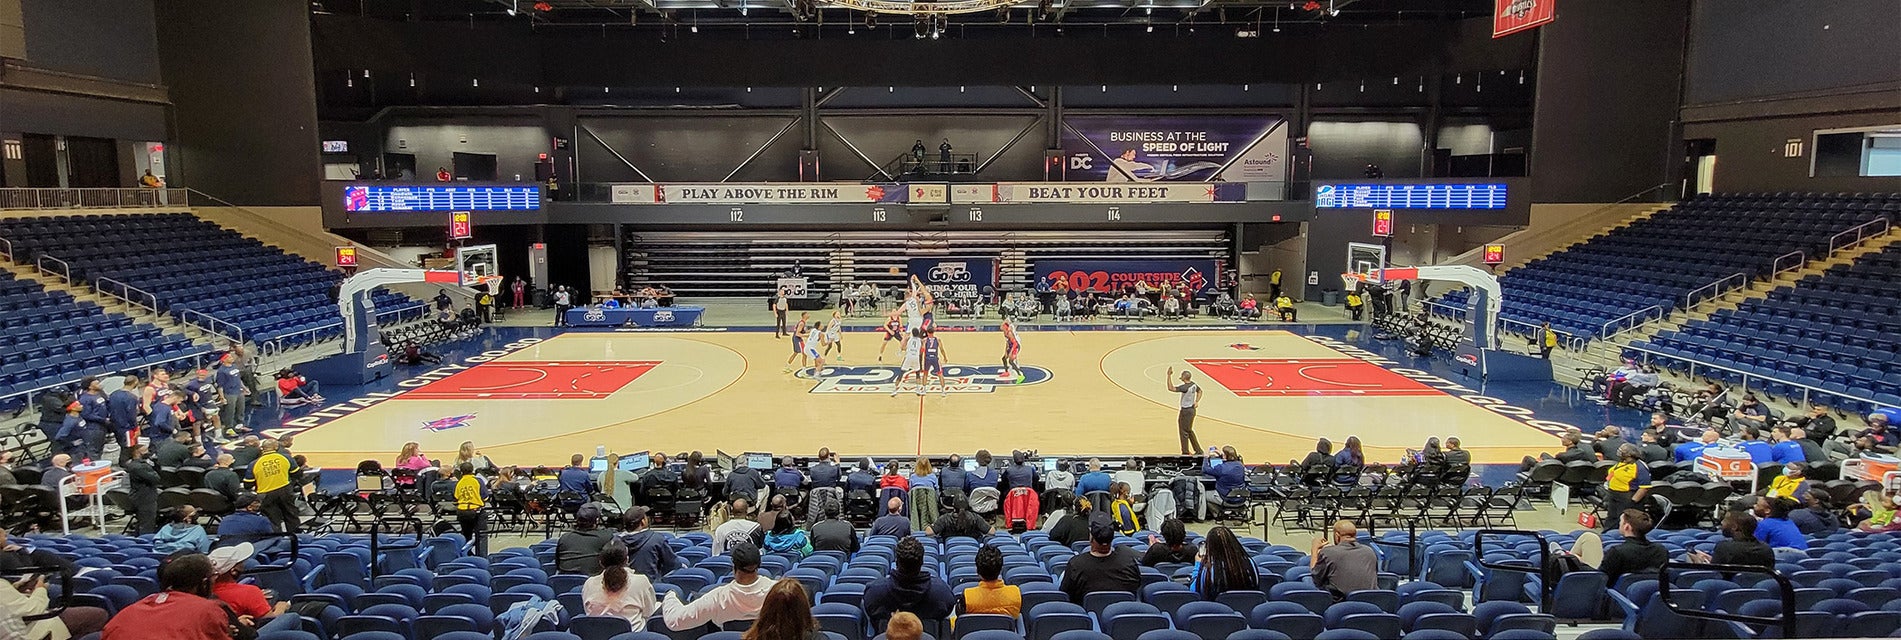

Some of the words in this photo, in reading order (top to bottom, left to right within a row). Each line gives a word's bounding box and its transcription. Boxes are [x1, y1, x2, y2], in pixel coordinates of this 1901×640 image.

[1110, 131, 1164, 142] BUSINESS
[1166, 131, 1181, 141] AT
[1183, 131, 1207, 141] THE
[5, 144, 22, 159] 111
[1142, 142, 1177, 152] SPEED
[1179, 142, 1195, 152] OF
[1197, 142, 1229, 152] LIGHT
[1785, 142, 1803, 157] 101
[682, 188, 719, 199] PLAY
[724, 188, 774, 199] ABOVE
[777, 188, 807, 199] THE
[810, 188, 838, 199] RIM
[1029, 187, 1073, 199] BEAT
[1077, 187, 1123, 199] YOUR
[1127, 187, 1169, 199] FEET
[730, 210, 743, 222] 112
[873, 210, 886, 222] 113
[969, 210, 982, 222] 113
[1107, 209, 1120, 221] 114
[455, 222, 466, 235] 24
[341, 255, 352, 263] 24
[1488, 252, 1500, 260] 24
[1048, 271, 1111, 294] 202
[1111, 272, 1181, 282] COURTSIDE
[952, 284, 977, 292] YOUR
[1388, 367, 1480, 394] CITY
[240, 389, 408, 443] APITAL
[397, 363, 470, 388] CITY
[262, 458, 281, 467] CSC
[1729, 461, 1741, 472] G
